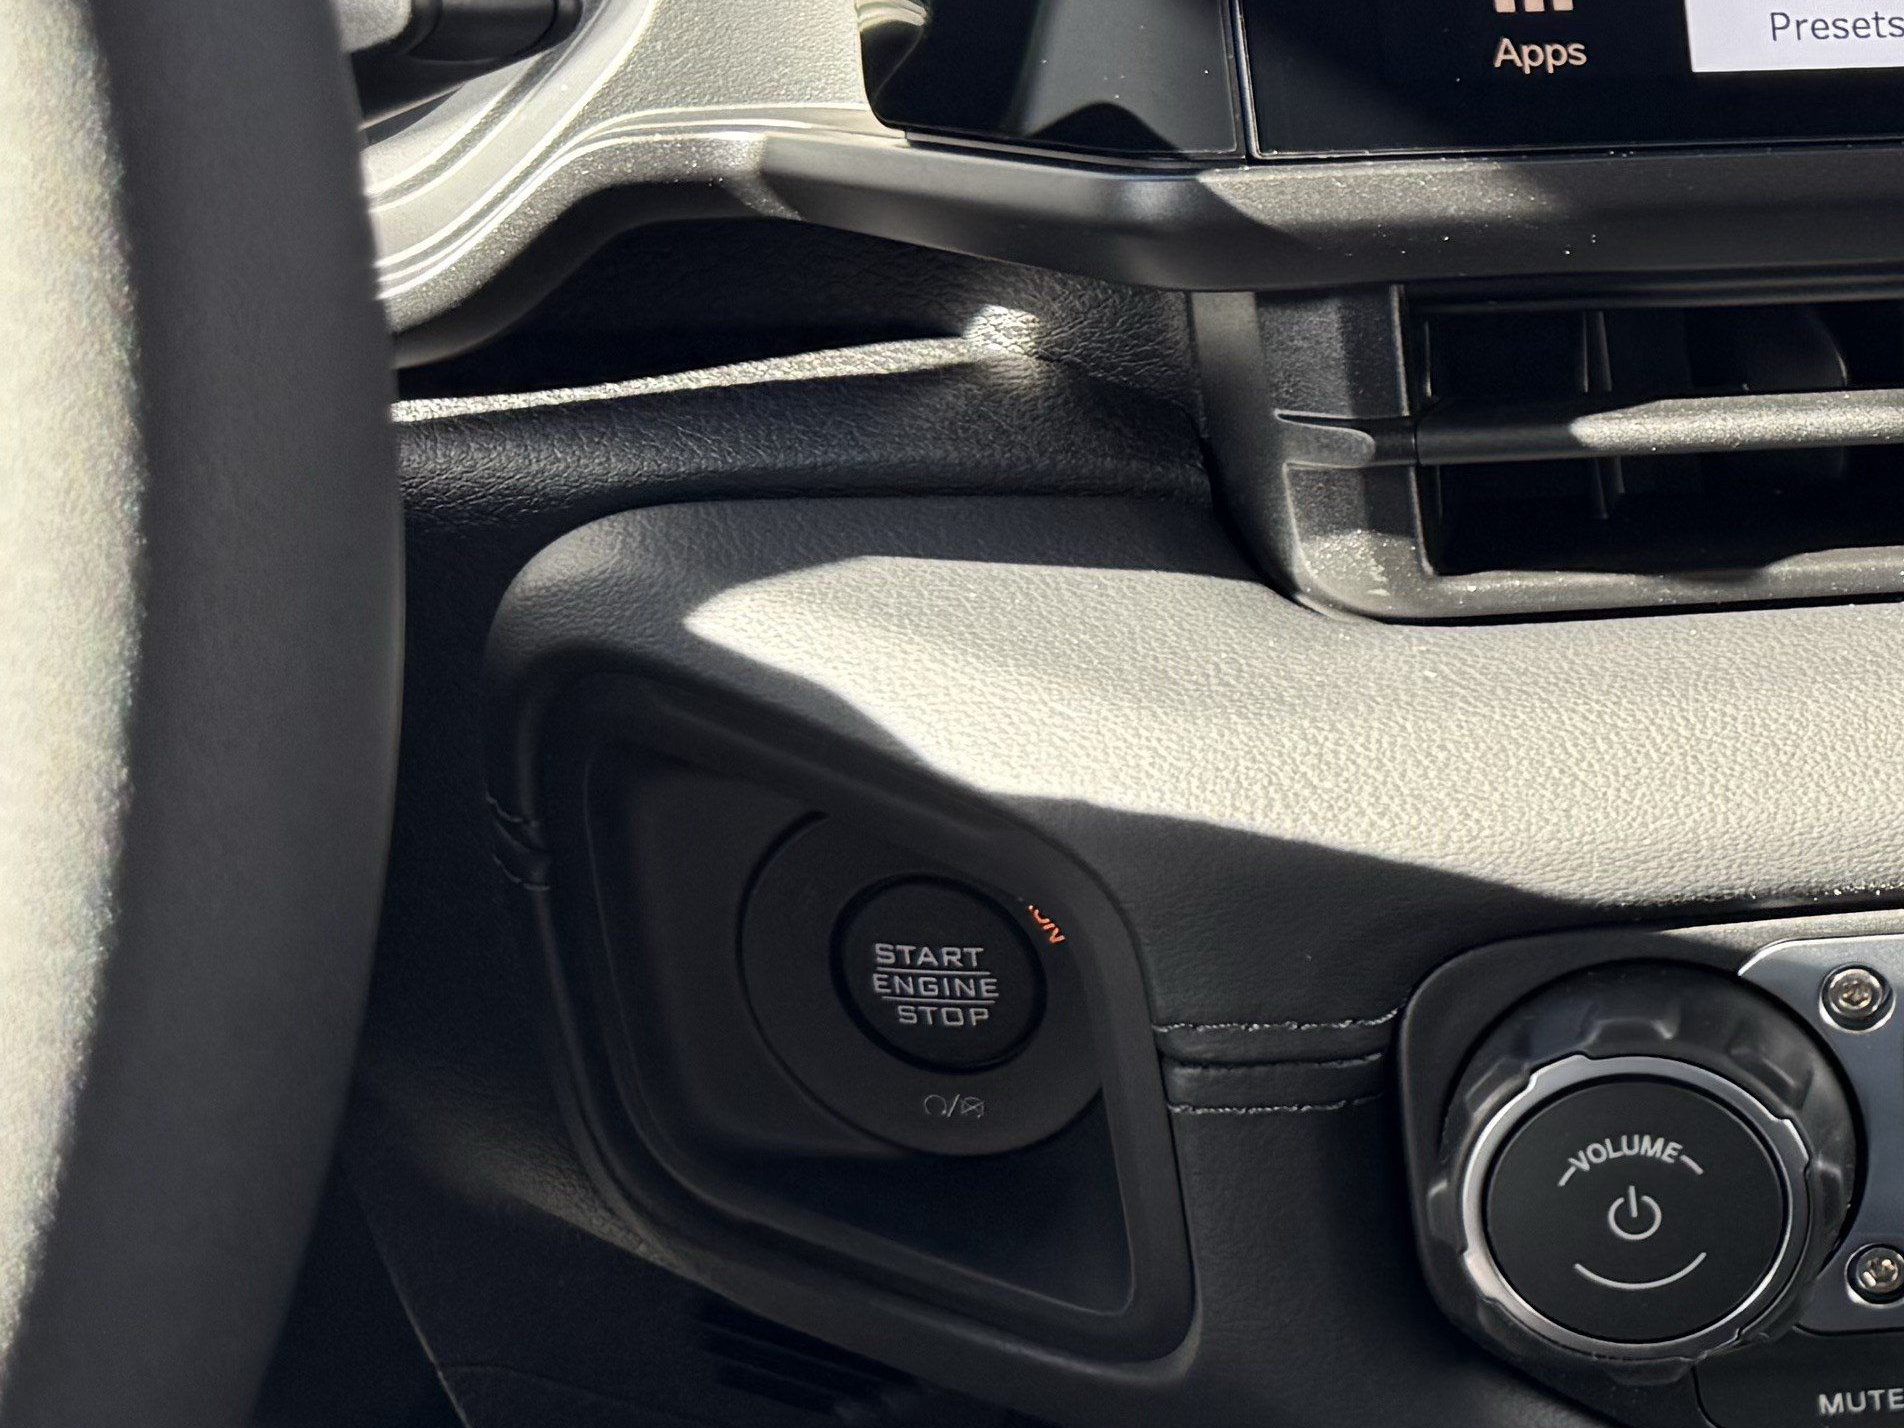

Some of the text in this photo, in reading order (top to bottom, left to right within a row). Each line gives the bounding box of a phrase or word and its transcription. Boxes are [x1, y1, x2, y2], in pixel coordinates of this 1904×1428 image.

[1493, 36, 1588, 74] Apps
[1027, 903, 1067, 945] UN
[873, 942, 984, 968] START
[872, 973, 1000, 999] ENGINE
[897, 1004, 990, 1027] STOP
[1567, 1134, 1684, 1172] VOLUME
